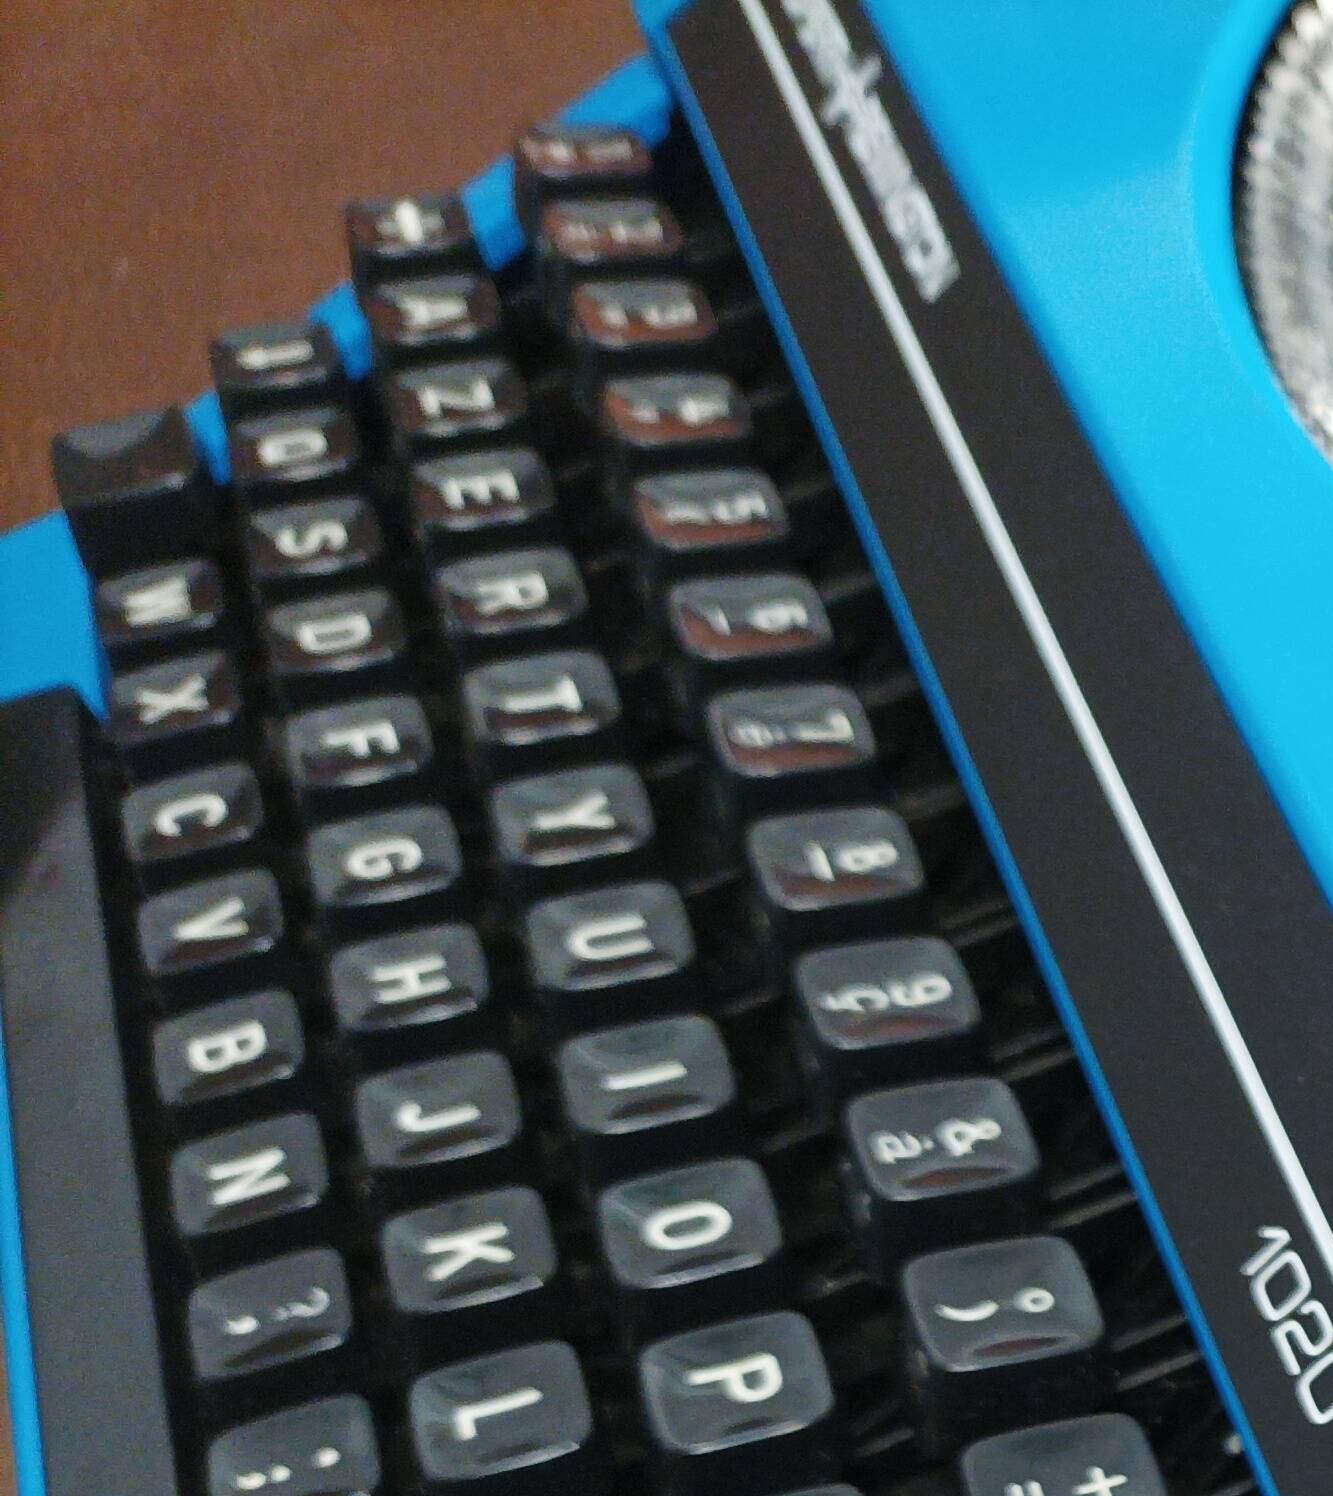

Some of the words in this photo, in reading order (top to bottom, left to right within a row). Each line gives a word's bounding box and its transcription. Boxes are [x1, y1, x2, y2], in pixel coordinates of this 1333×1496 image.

[418, 378, 494, 416] Z
[440, 468, 518, 508] E
[274, 520, 348, 556] S
[473, 571, 548, 614] R
[296, 614, 372, 652] D
[135, 674, 208, 724] X
[504, 676, 581, 712] T
[322, 720, 399, 756] F
[798, 711, 854, 741] 7
[154, 792, 228, 836] C
[532, 792, 615, 830] Y
[345, 838, 422, 878] G
[837, 838, 898, 872] 8
[174, 898, 249, 940] V
[567, 913, 653, 960] U
[372, 954, 450, 1004] H
[893, 974, 953, 1007] 9
[186, 1020, 267, 1074] B
[604, 1061, 687, 1090] I
[396, 1102, 480, 1132] J
[938, 1118, 1002, 1158] &
[208, 1148, 290, 1205] N
[642, 1200, 732, 1251] O
[422, 1224, 514, 1281] K
[686, 1352, 784, 1402] P
[452, 1388, 542, 1440] L
